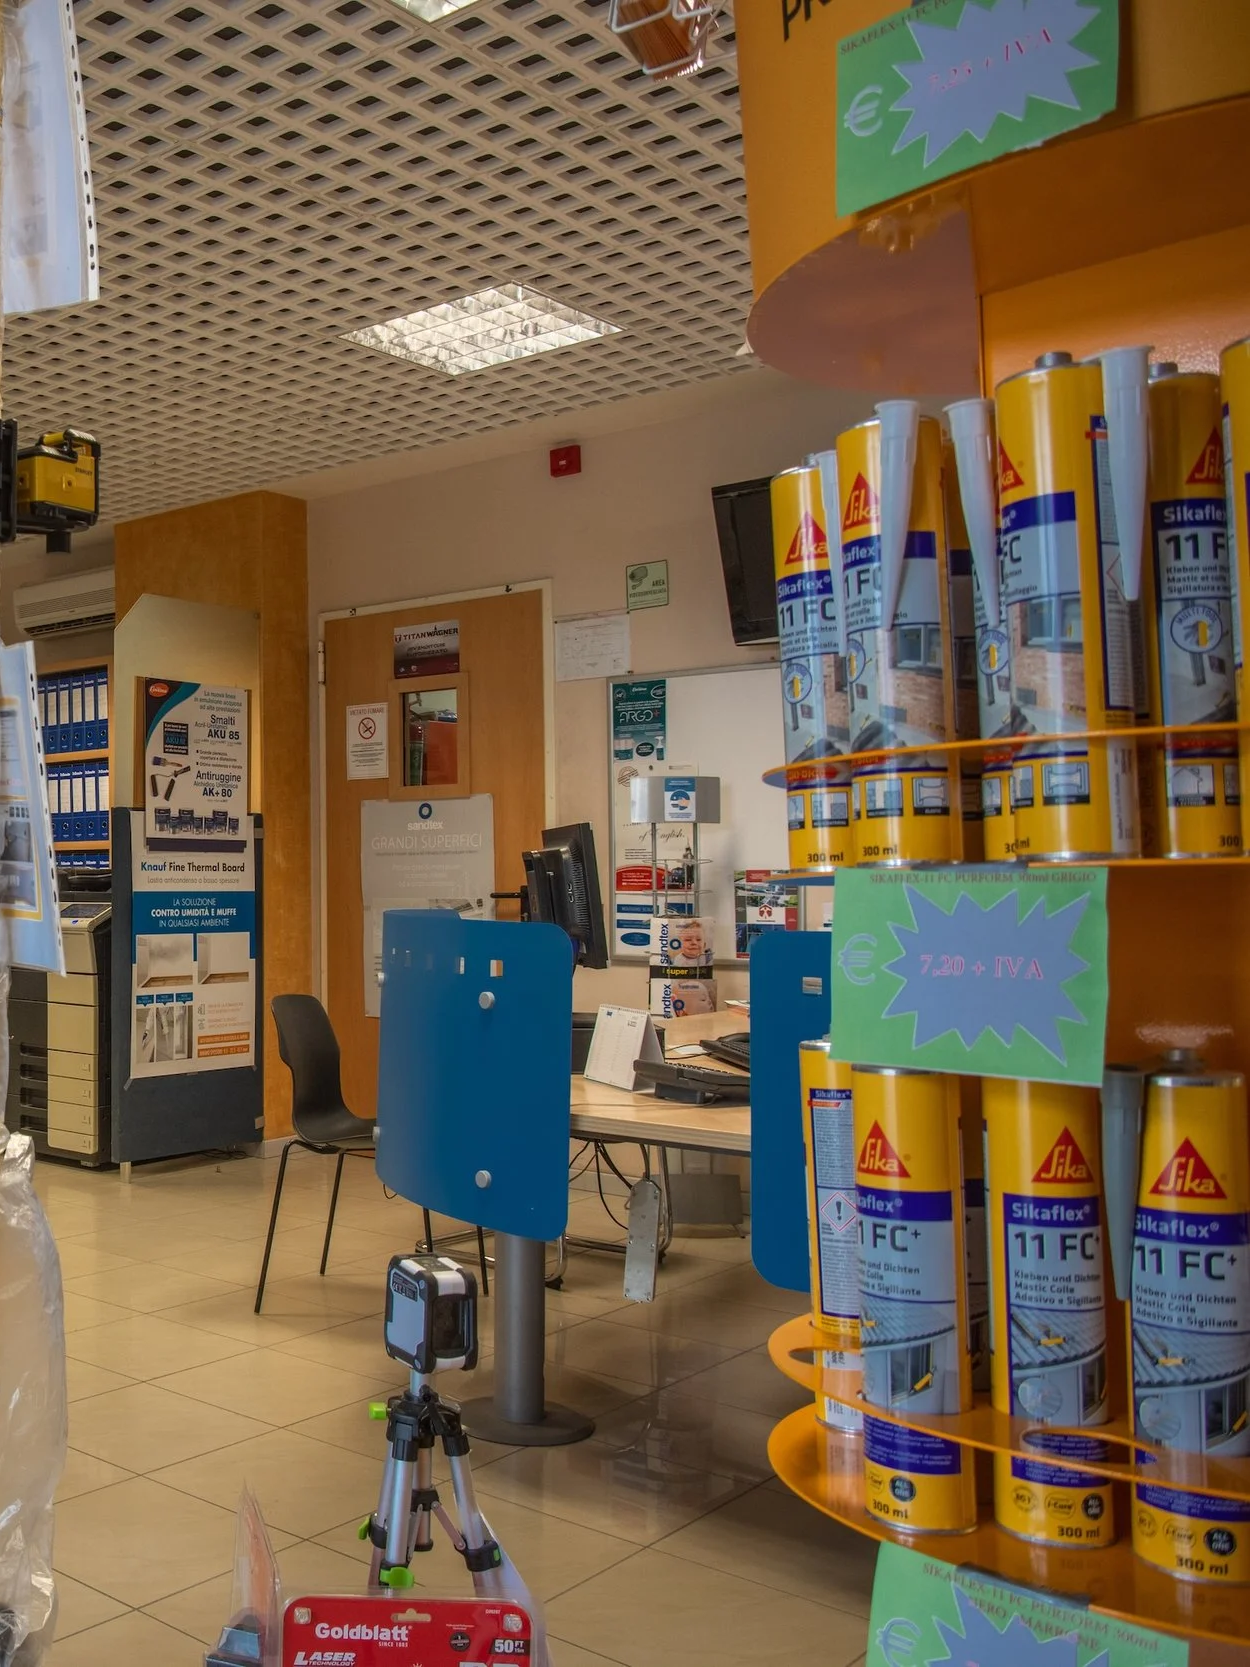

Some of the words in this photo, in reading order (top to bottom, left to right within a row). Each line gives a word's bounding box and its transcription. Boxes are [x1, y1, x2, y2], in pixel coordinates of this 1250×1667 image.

[652, 579, 665, 587] AREA
[211, 714, 235, 726] Smalti
[207, 729, 226, 739] AKU
[229, 731, 240, 740] 85
[196, 771, 241, 783] Antiruggine
[407, 820, 444, 830] sandtex
[371, 836, 417, 849] GRANDI
[421, 833, 482, 848] SUPERFICI
[141, 862, 166, 872] Knauf
[169, 862, 186, 872] Fine
[188, 862, 220, 872] Thermal
[222, 862, 245, 872] Board
[182, 898, 217, 906] SOLUZIONE
[151, 909, 180, 917] CONTRO
[182, 907, 209, 916] UMIDITÀ
[217, 908, 237, 916] MUFFE
[168, 920, 200, 928] QUALSIASI
[660, 923, 669, 965] sandtex
[666, 969, 688, 977] super
[994, 956, 1044, 980] IVA
[663, 984, 672, 1019] andtex
[860, 1138, 899, 1172] Sika
[1041, 1146, 1087, 1180] Sika
[1159, 1157, 1215, 1194] Sika
[1014, 1232, 1045, 1261] 11
[1135, 1245, 1164, 1275] 11
[884, 1263, 920, 1275] Dichten
[1014, 1270, 1049, 1282] Kleben
[1052, 1272, 1070, 1283] und
[877, 1283, 921, 1296] Sigillante
[1014, 1282, 1047, 1293] Mastic
[1050, 1284, 1075, 1294] Colle
[1136, 1284, 1167, 1299] Kleben
[1171, 1292, 1192, 1303] und
[1196, 1293, 1237, 1304] Dichten
[1014, 1292, 1055, 1304] Adesivo
[1168, 1301, 1196, 1314] Colle
[1136, 1307, 1174, 1323] Adesivo
[1186, 1314, 1238, 1329] Sigillante
[892, 1508, 909, 1520] ml
[1057, 1525, 1083, 1538] 300
[1086, 1525, 1100, 1538] ml
[1176, 1556, 1205, 1572] 300
[1209, 1562, 1229, 1575] ml
[315, 1623, 409, 1641] Goldblatt
[494, 1640, 513, 1653] 50
[294, 1652, 357, 1665] LASER
